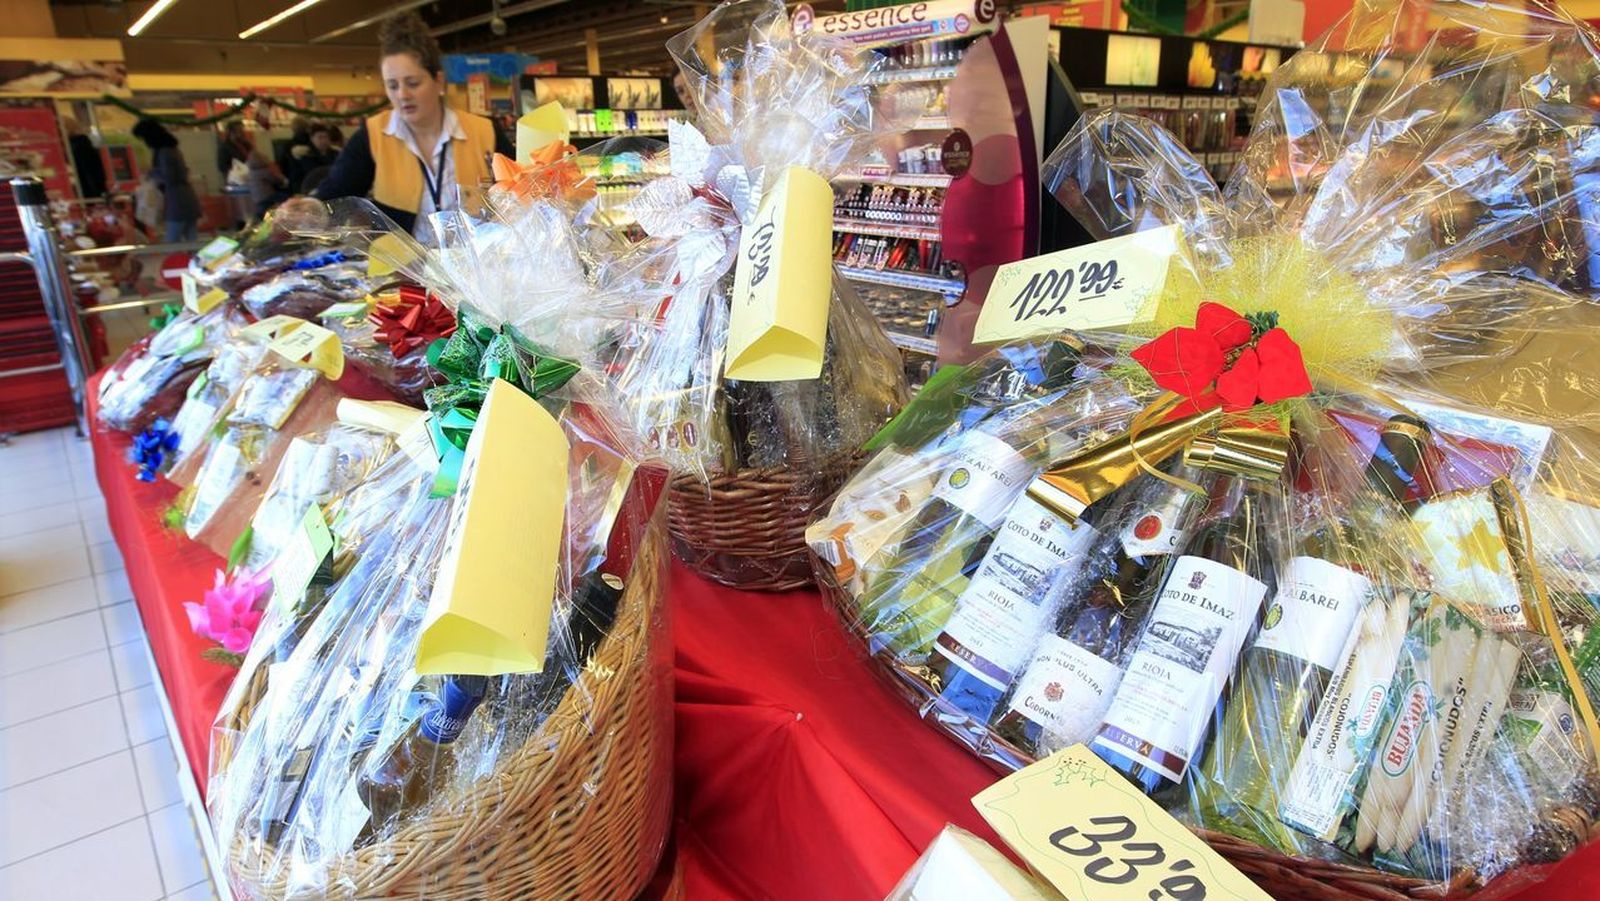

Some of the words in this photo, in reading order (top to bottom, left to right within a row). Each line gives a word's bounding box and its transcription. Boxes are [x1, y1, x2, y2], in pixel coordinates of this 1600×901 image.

[823, 3, 928, 34] essence
[1007, 520, 1030, 538] COTO
[1031, 533, 1044, 546] DE
[987, 590, 1015, 611] RIOJA
[1181, 592, 1198, 605] DE
[1200, 595, 1236, 621] IMAZ
[1142, 661, 1172, 680] RIOJA
